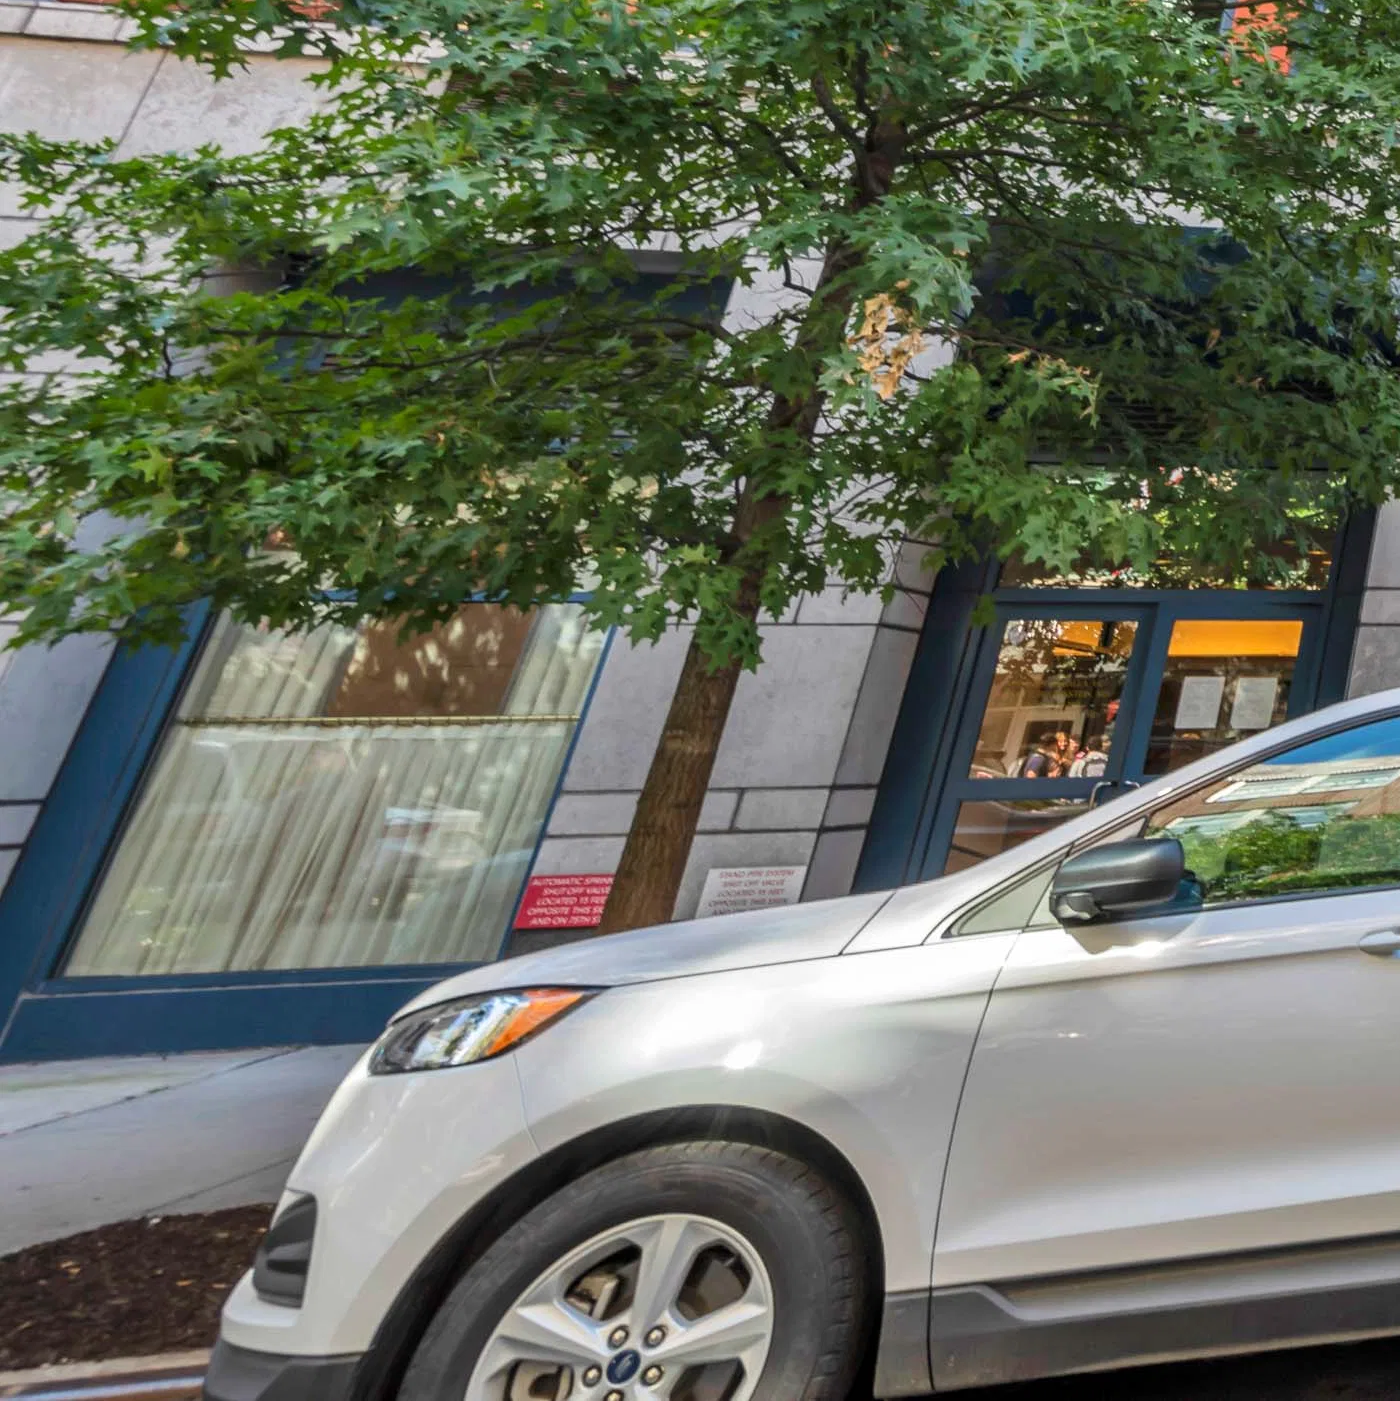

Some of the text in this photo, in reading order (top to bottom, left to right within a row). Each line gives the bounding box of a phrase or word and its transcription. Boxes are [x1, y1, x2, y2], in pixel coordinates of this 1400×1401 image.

[532, 877, 583, 886] AUTOMATIC
[536, 896, 578, 906] LOCATED
[526, 906, 570, 916] OPPOSITE
[529, 916, 552, 926] AND
[551, 916, 568, 926] ON
